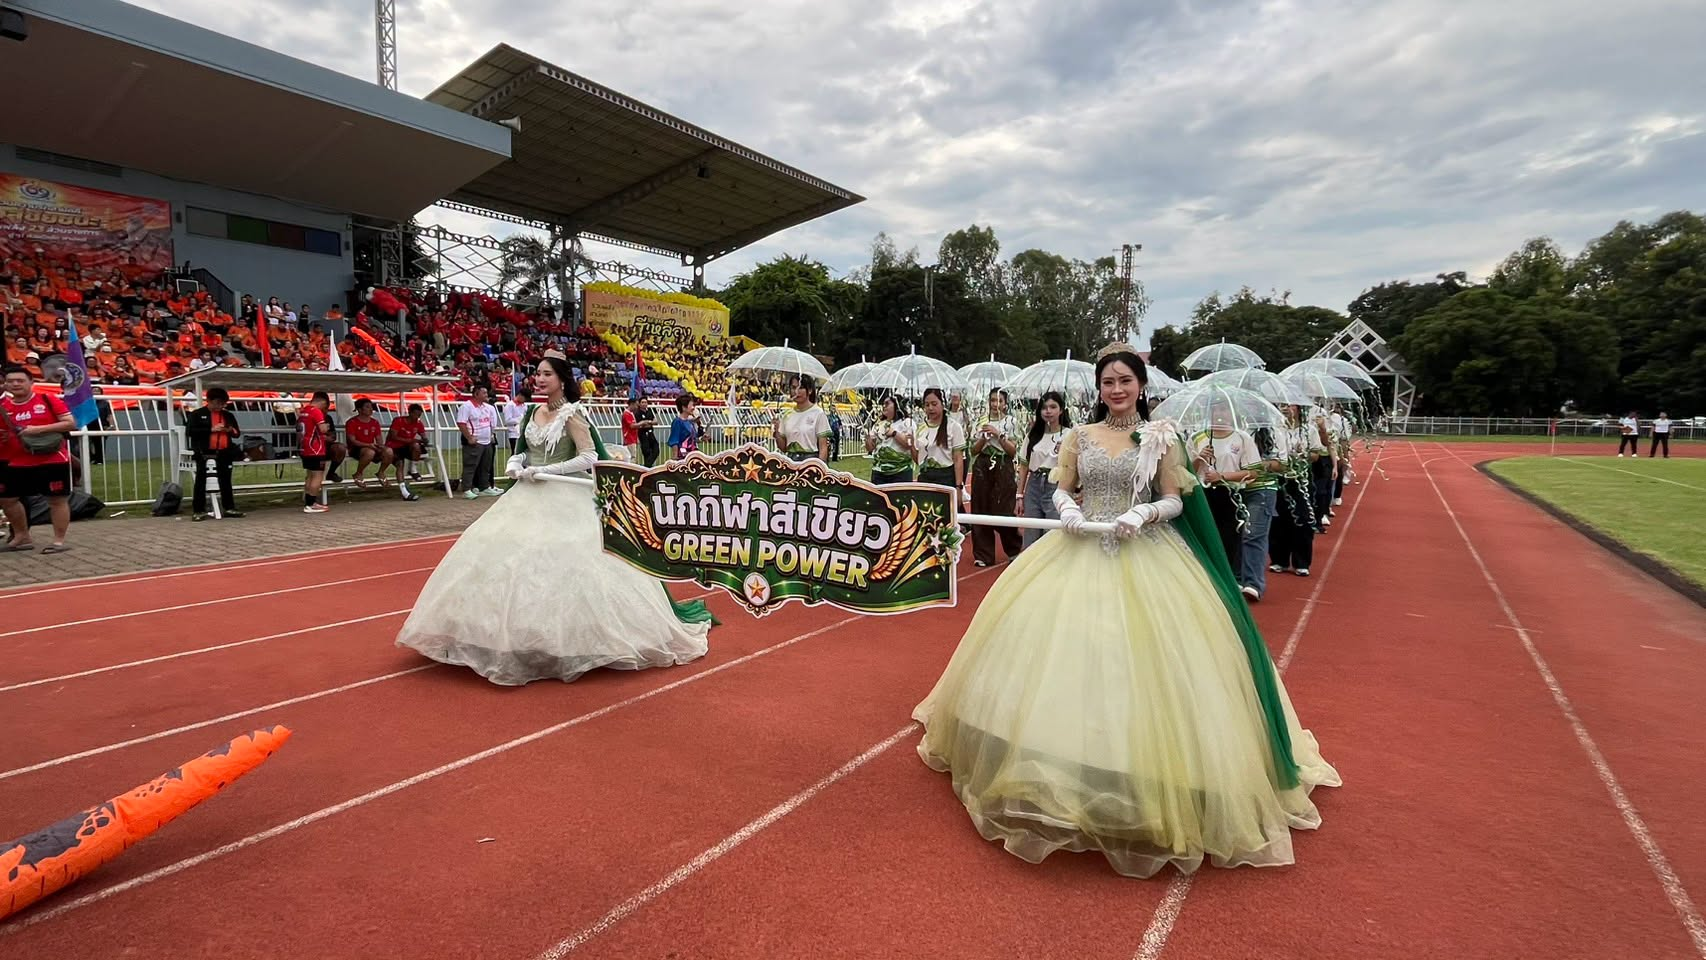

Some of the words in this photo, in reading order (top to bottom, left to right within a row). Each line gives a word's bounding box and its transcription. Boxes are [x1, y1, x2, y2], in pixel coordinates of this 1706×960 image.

[651, 482, 891, 551] นักกีฬาสีเขียว
[663, 532, 752, 567] GREEN
[757, 540, 871, 588] POWER
